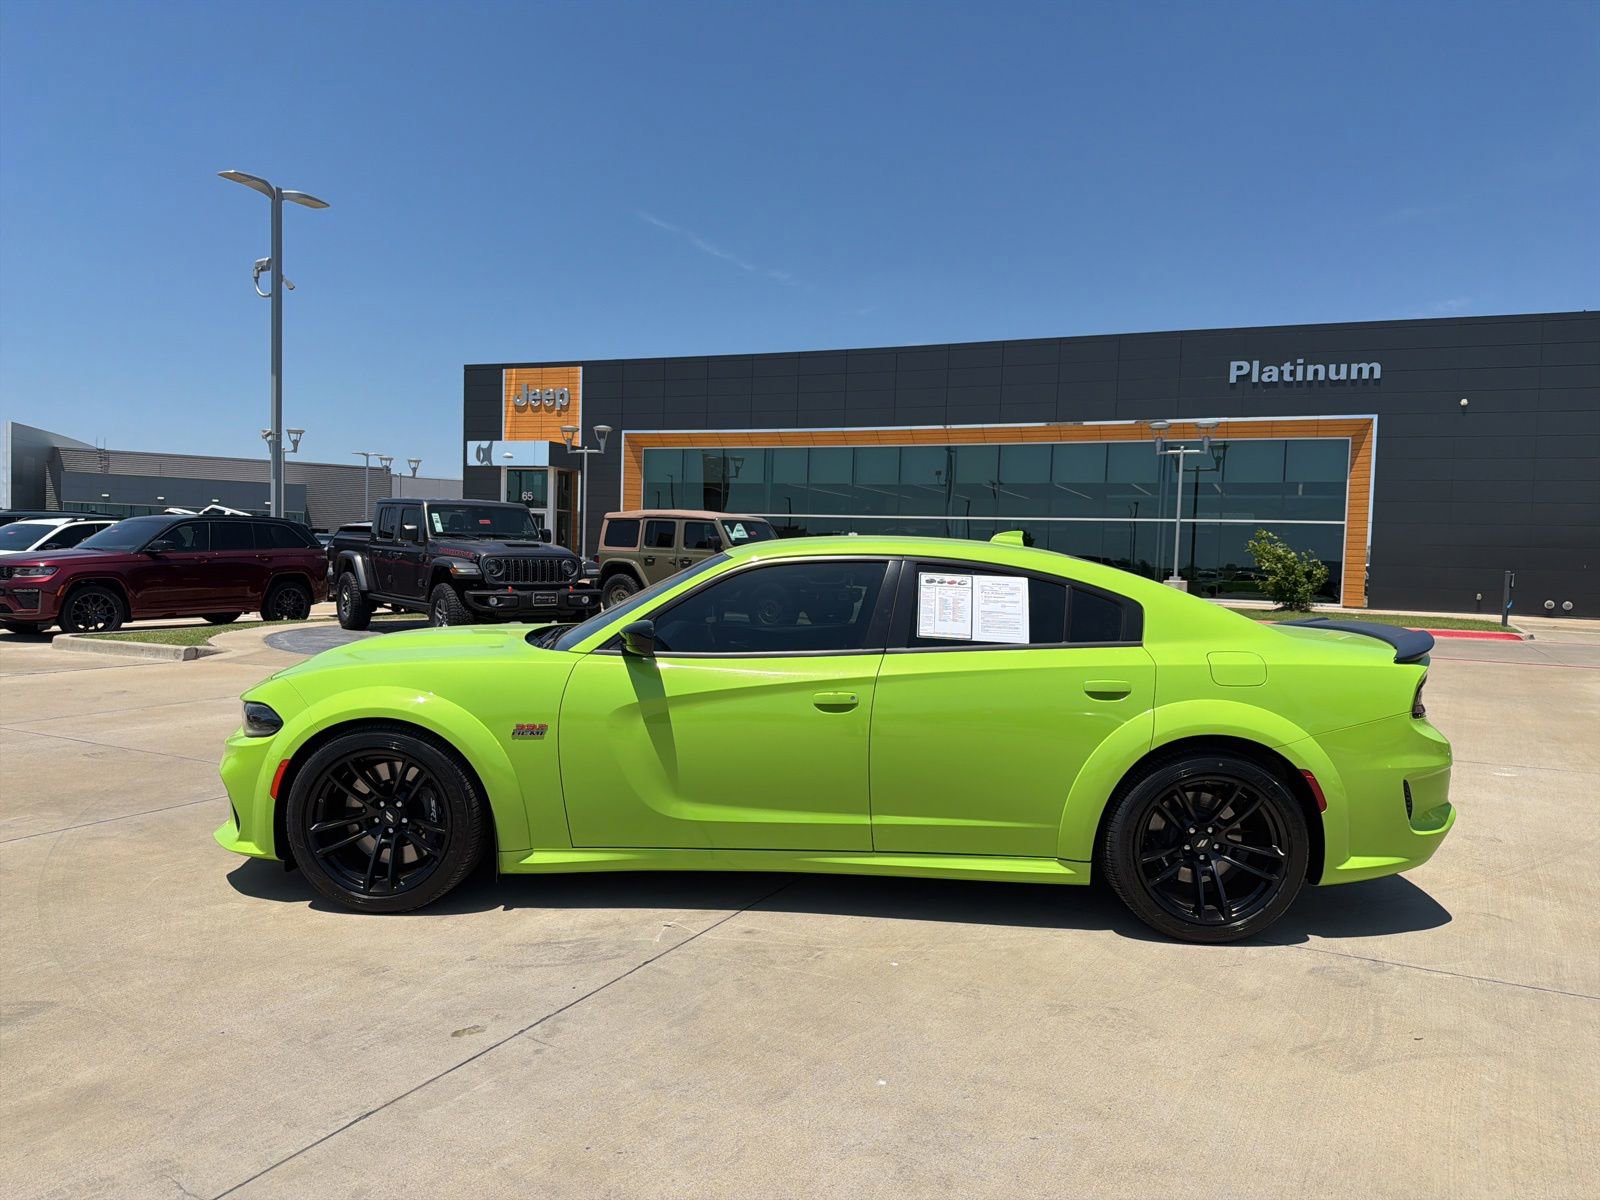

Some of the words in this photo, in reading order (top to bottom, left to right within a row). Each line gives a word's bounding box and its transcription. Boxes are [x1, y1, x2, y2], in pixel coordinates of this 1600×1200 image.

[1229, 358, 1382, 384] Platinum
[512, 383, 570, 411] Jeep
[521, 491, 534, 501] 65
